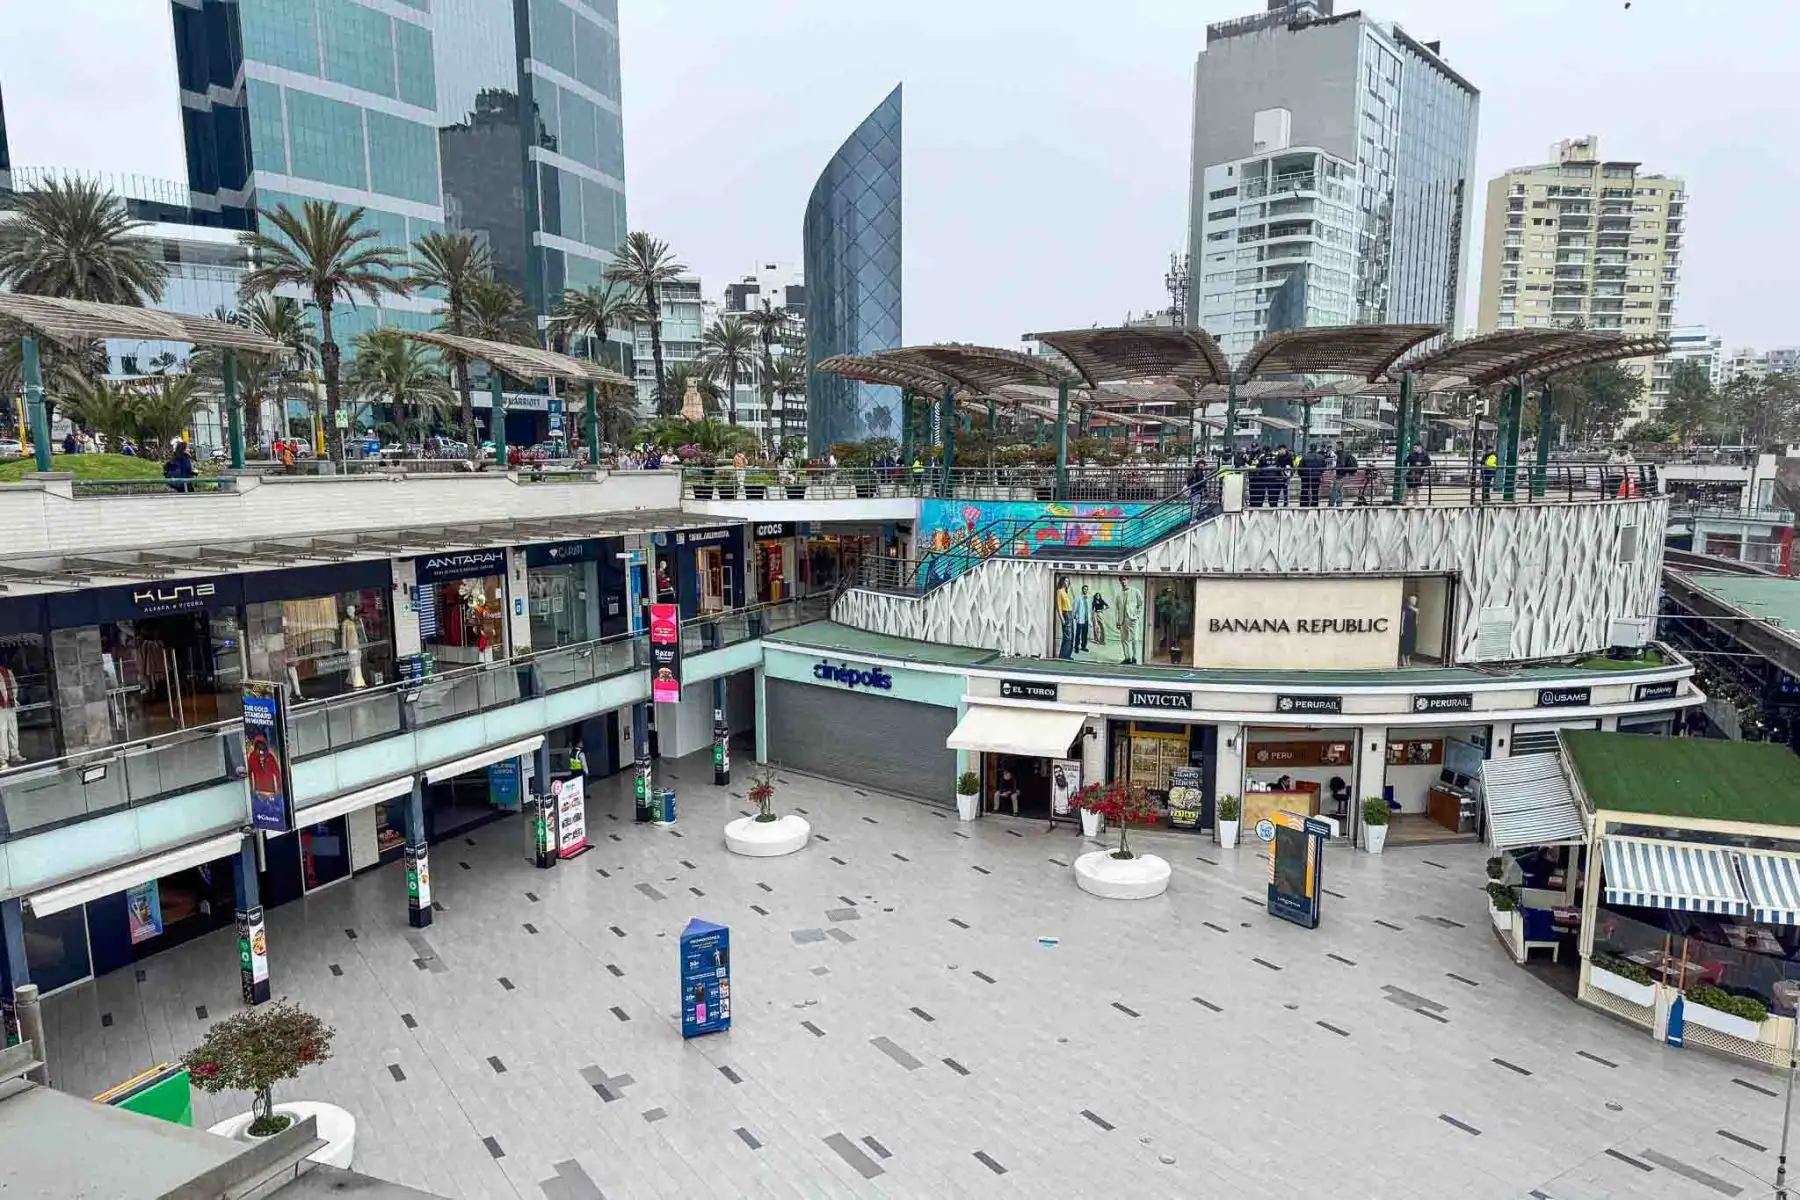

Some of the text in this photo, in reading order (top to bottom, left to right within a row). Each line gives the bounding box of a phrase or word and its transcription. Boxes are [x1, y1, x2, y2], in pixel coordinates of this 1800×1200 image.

[758, 523, 783, 536] crocs
[426, 552, 504, 569] ANNTARAH
[1209, 618, 1388, 633] BANANA REPUBLIC
[814, 659, 892, 689] cinépolis
[1012, 686, 1055, 696] EL TURCO
[1133, 693, 1187, 707] INVICTA
[1554, 693, 1587, 702] USAMS
[1295, 701, 1339, 711] PERURAIL
[1430, 699, 1469, 708] PERURAIL
[244, 711, 272, 720] STANDARD
[1271, 752, 1293, 760] PERU
